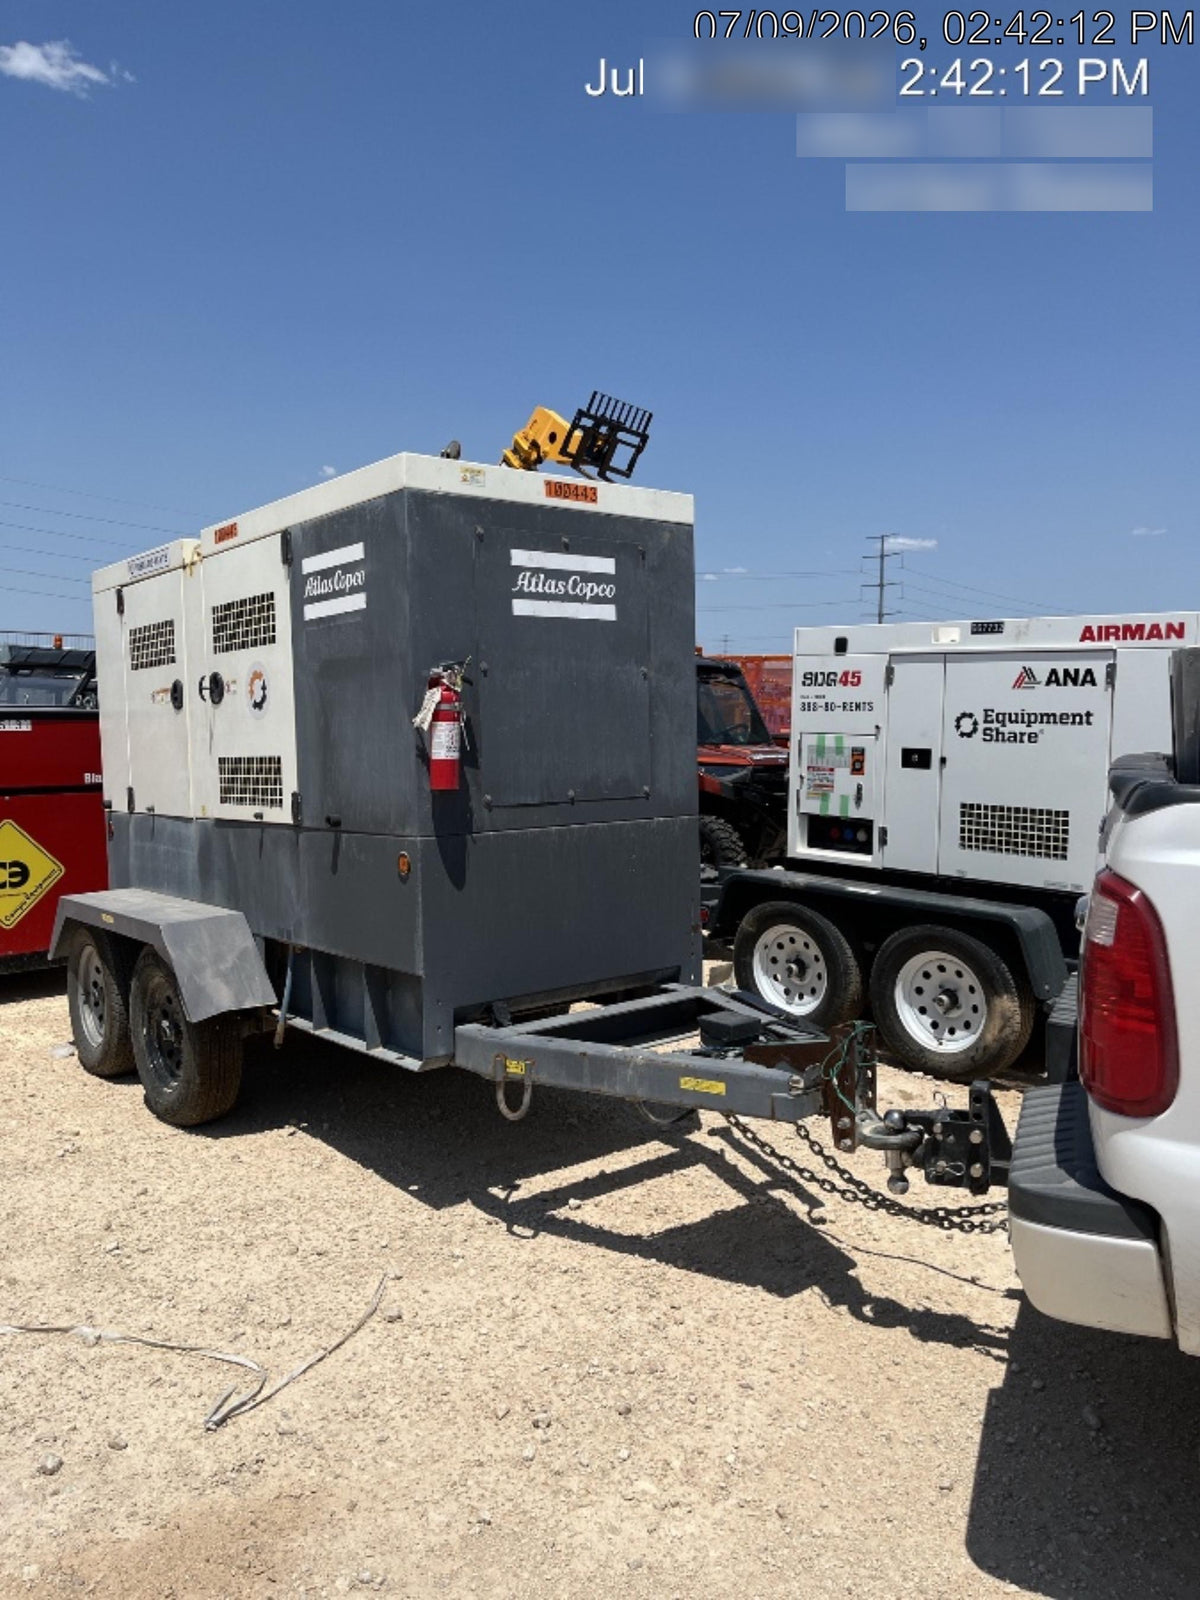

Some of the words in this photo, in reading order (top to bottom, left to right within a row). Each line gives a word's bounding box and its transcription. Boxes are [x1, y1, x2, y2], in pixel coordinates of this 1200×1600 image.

[304, 576, 333, 598] Atlas
[334, 570, 365, 593] Copco
[511, 572, 566, 595] Atlas
[567, 576, 616, 601] Copco
[1079, 621, 1186, 642] AIRMAN
[1044, 668, 1098, 687] ANA
[982, 708, 1094, 728] Equipment
[982, 727, 1039, 743] Share
